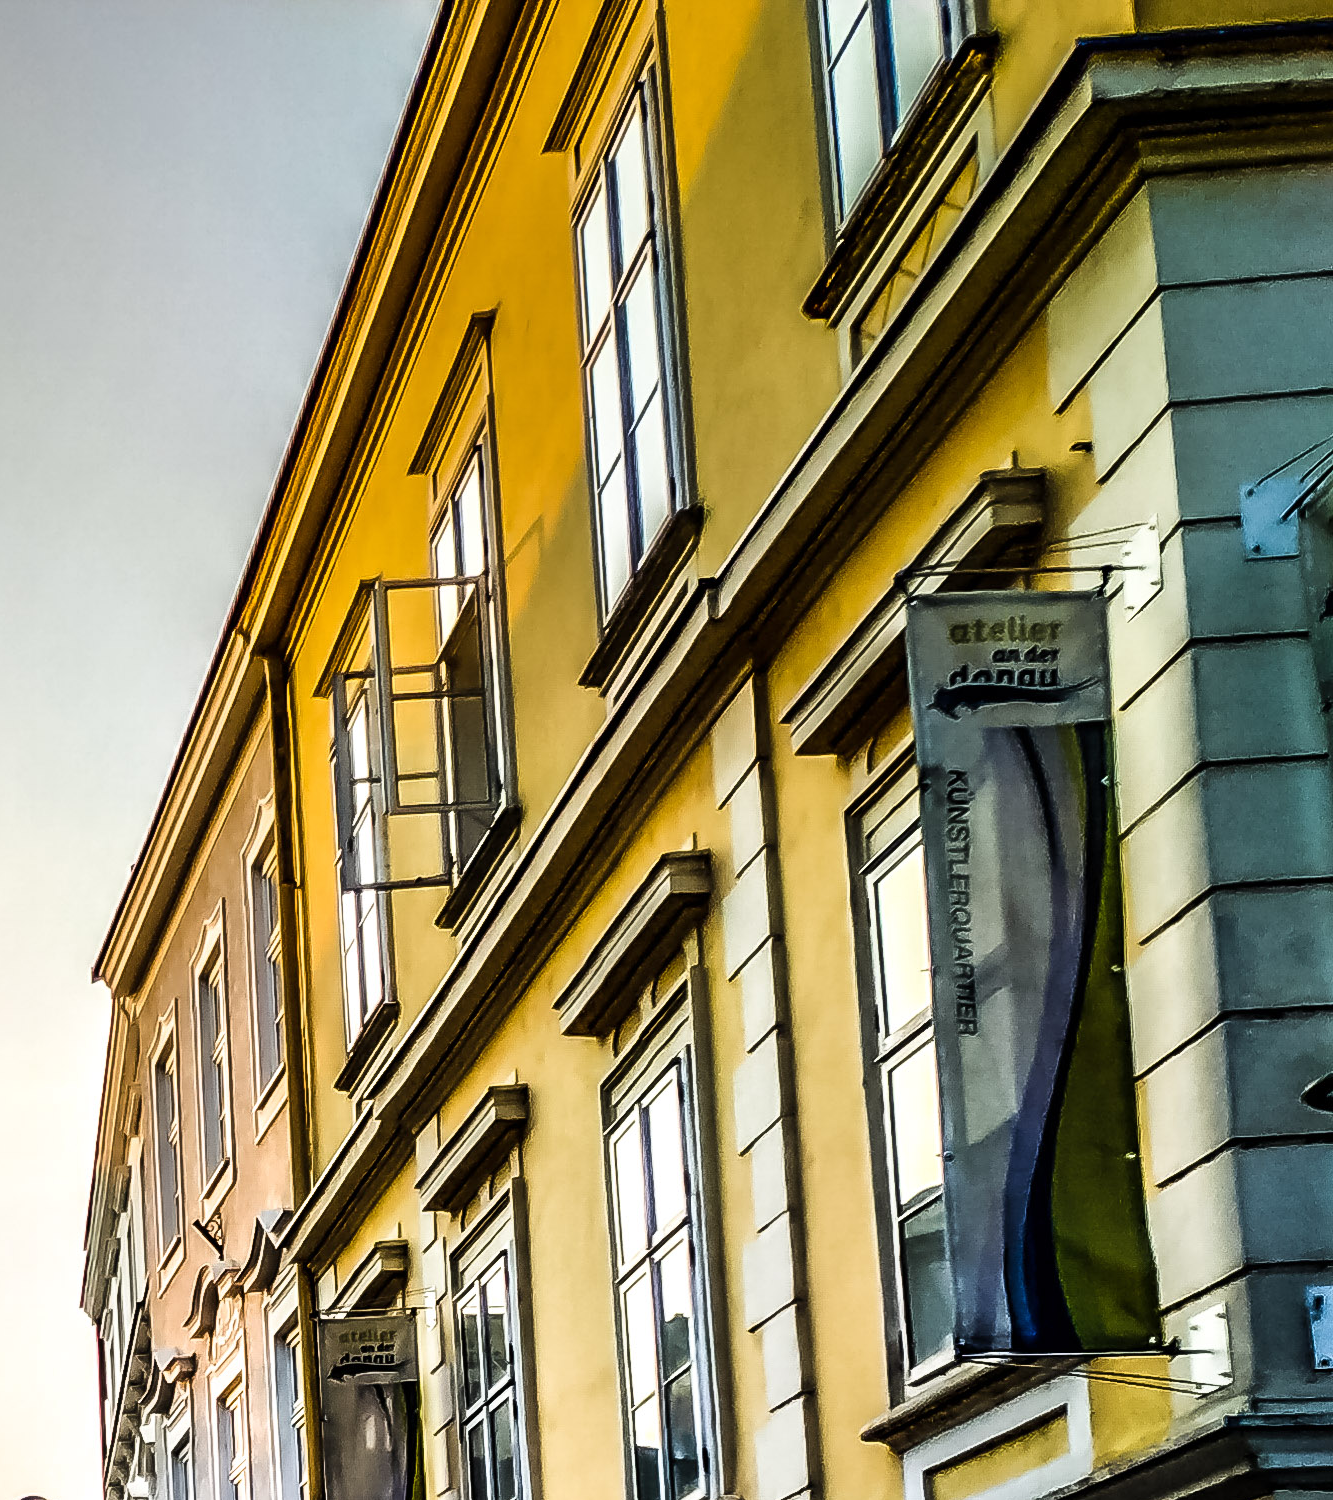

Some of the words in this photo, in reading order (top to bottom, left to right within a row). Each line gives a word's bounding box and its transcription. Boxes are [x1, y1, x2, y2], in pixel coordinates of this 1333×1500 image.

[948, 614, 1064, 645] atelier
[991, 648, 1021, 663] an
[1023, 644, 1060, 663] der
[948, 663, 1060, 687] donau
[946, 769, 979, 1037] KÜNSTLERQUARTIER
